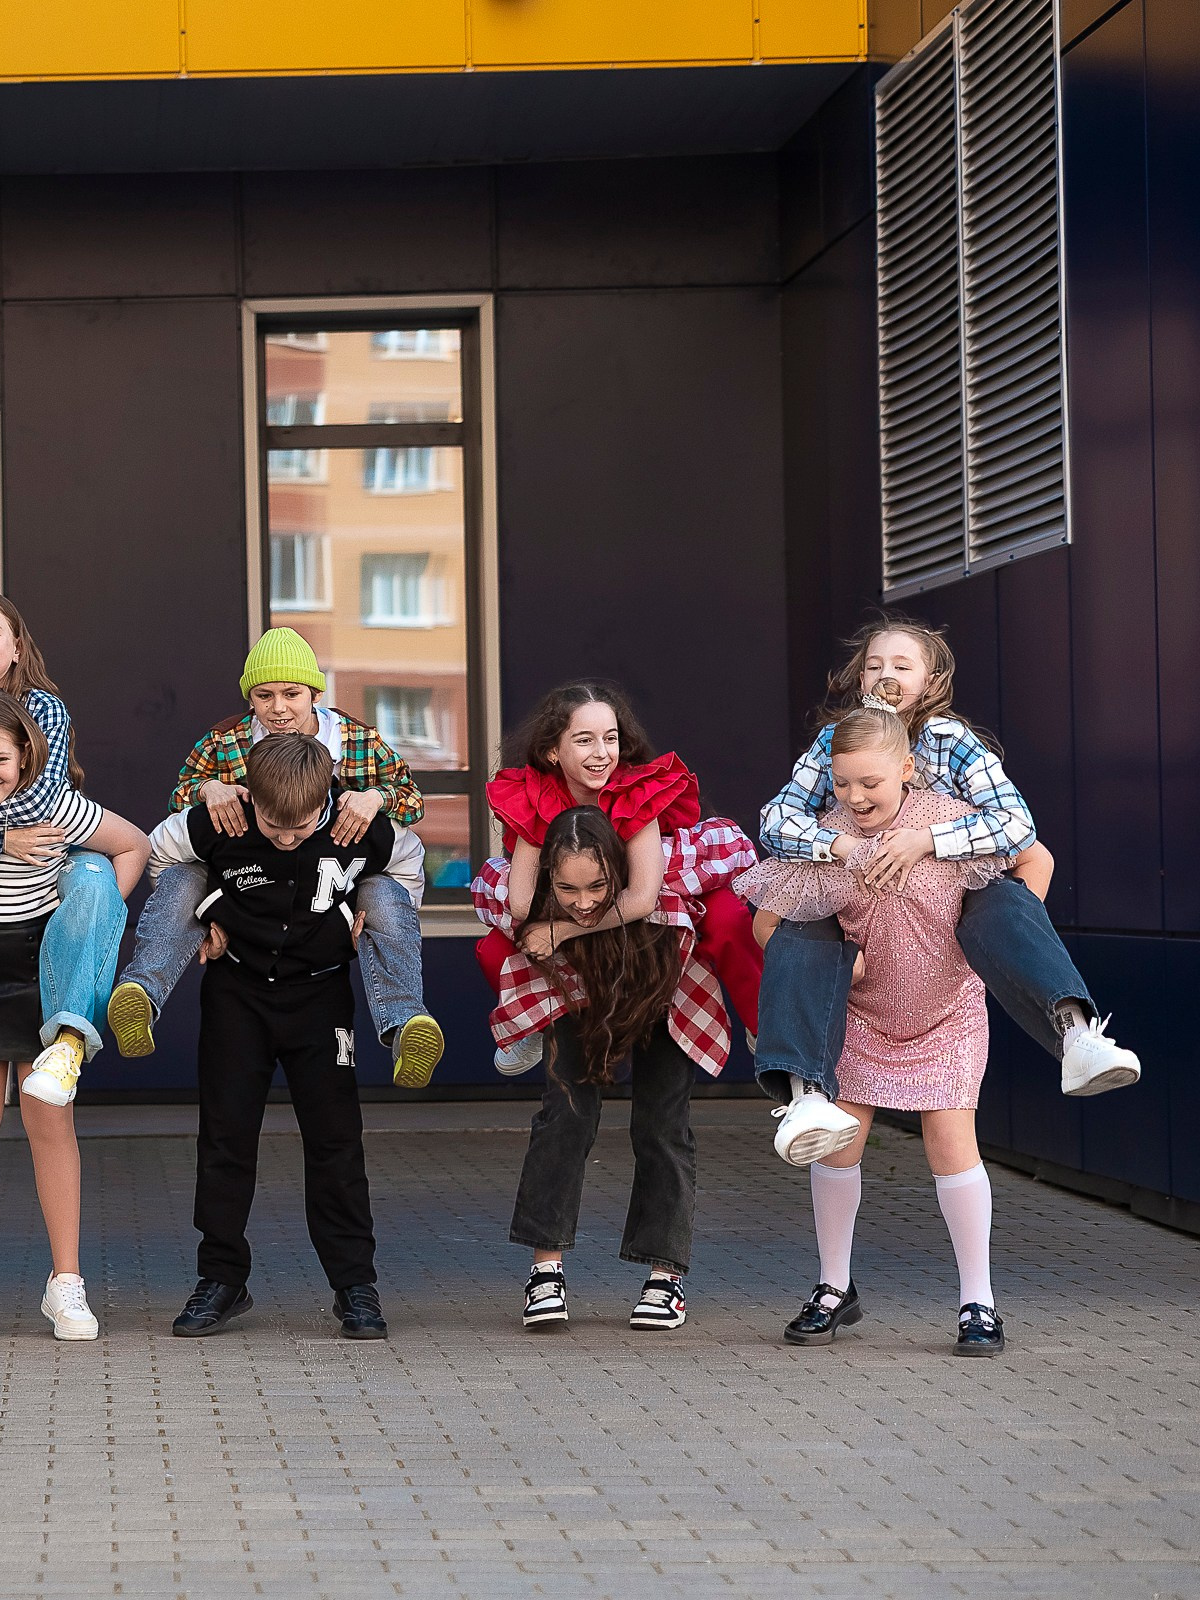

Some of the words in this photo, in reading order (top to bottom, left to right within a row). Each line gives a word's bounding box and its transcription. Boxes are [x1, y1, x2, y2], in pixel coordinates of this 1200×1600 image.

[222, 863, 263, 881] Minnesota
[236, 874, 268, 889] College
[310, 857, 367, 913] M
